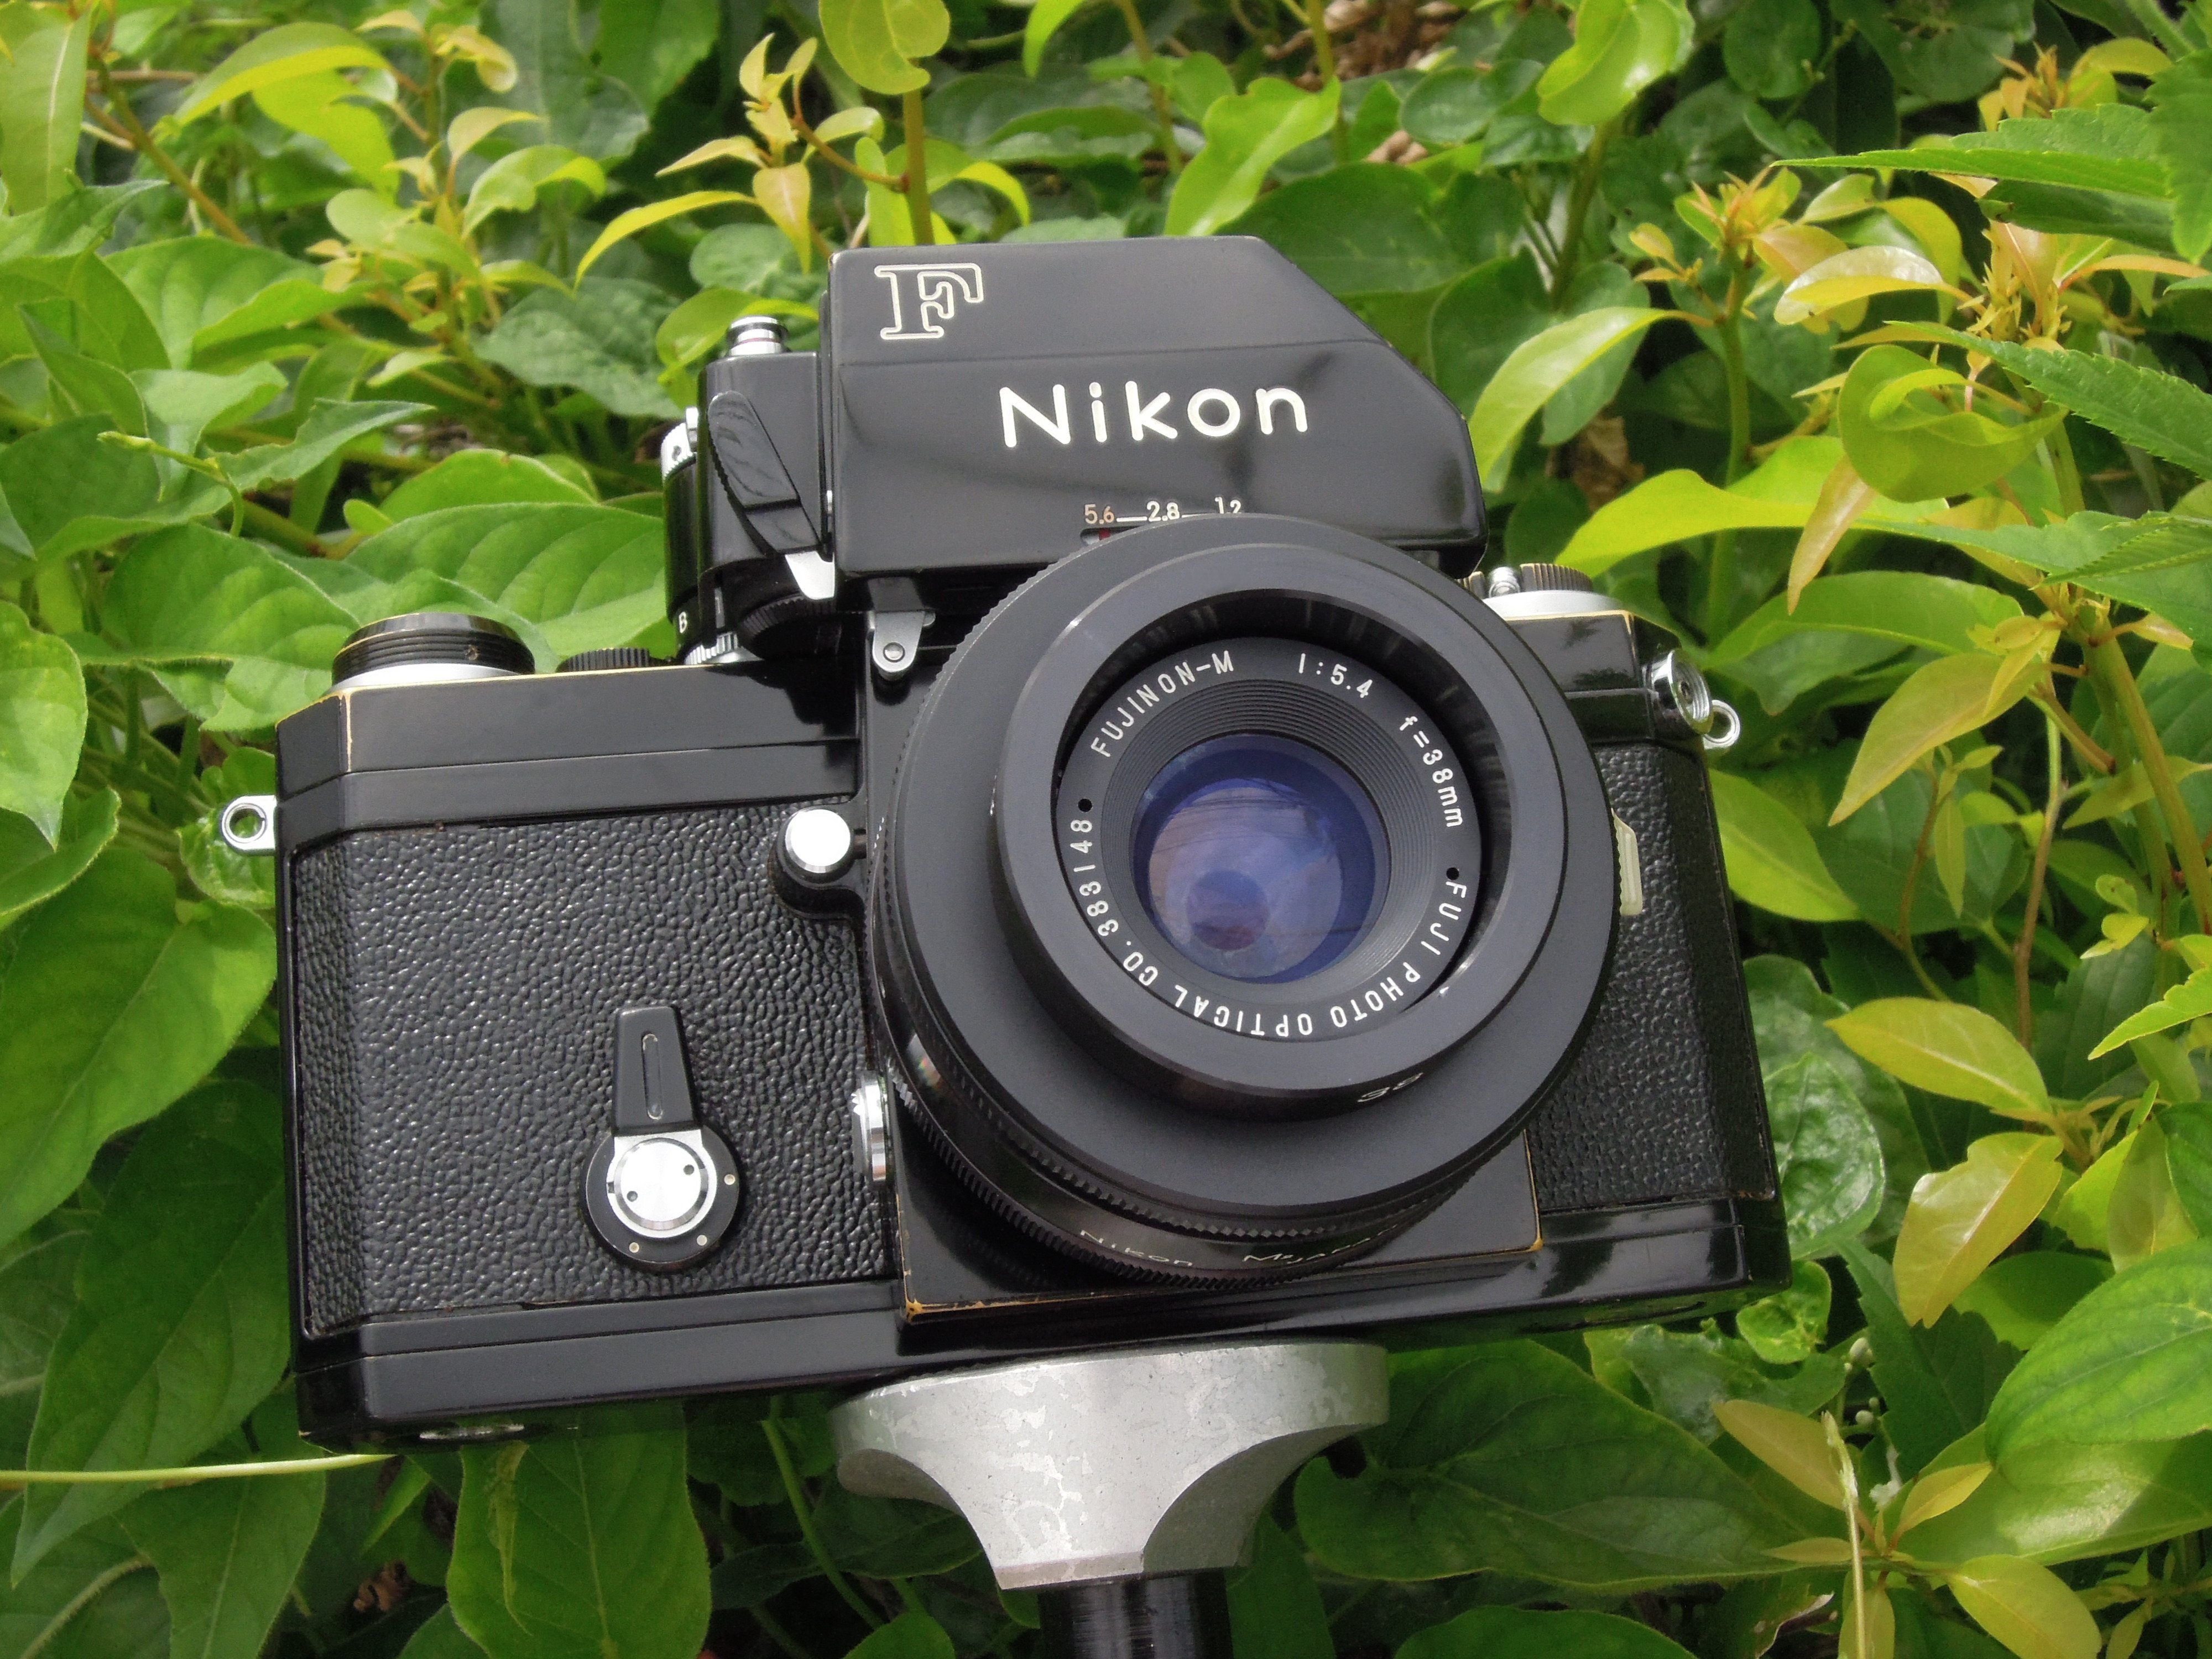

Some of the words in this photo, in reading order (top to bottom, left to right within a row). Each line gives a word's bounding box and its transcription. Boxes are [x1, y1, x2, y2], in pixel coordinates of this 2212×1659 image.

[874, 263, 984, 340] F
[999, 380, 1308, 448] Nikon
[1084, 504, 1114, 524] 5.6
[1146, 500, 1180, 522] 2.8
[679, 612, 687, 634] B
[1091, 650, 1234, 758] FUJINON-M
[1298, 653, 1373, 698] 1:5.4
[1399, 716, 1463, 827] f=38mm
[1070, 819, 1119, 936] 383148
[1421, 881, 1467, 955] FUJI
[1123, 941, 1159, 987] CO.
[1330, 962, 1421, 1028] PHOTO
[1175, 984, 1313, 1037] OPTICAL
[1080, 1230, 1193, 1266] Nikon
